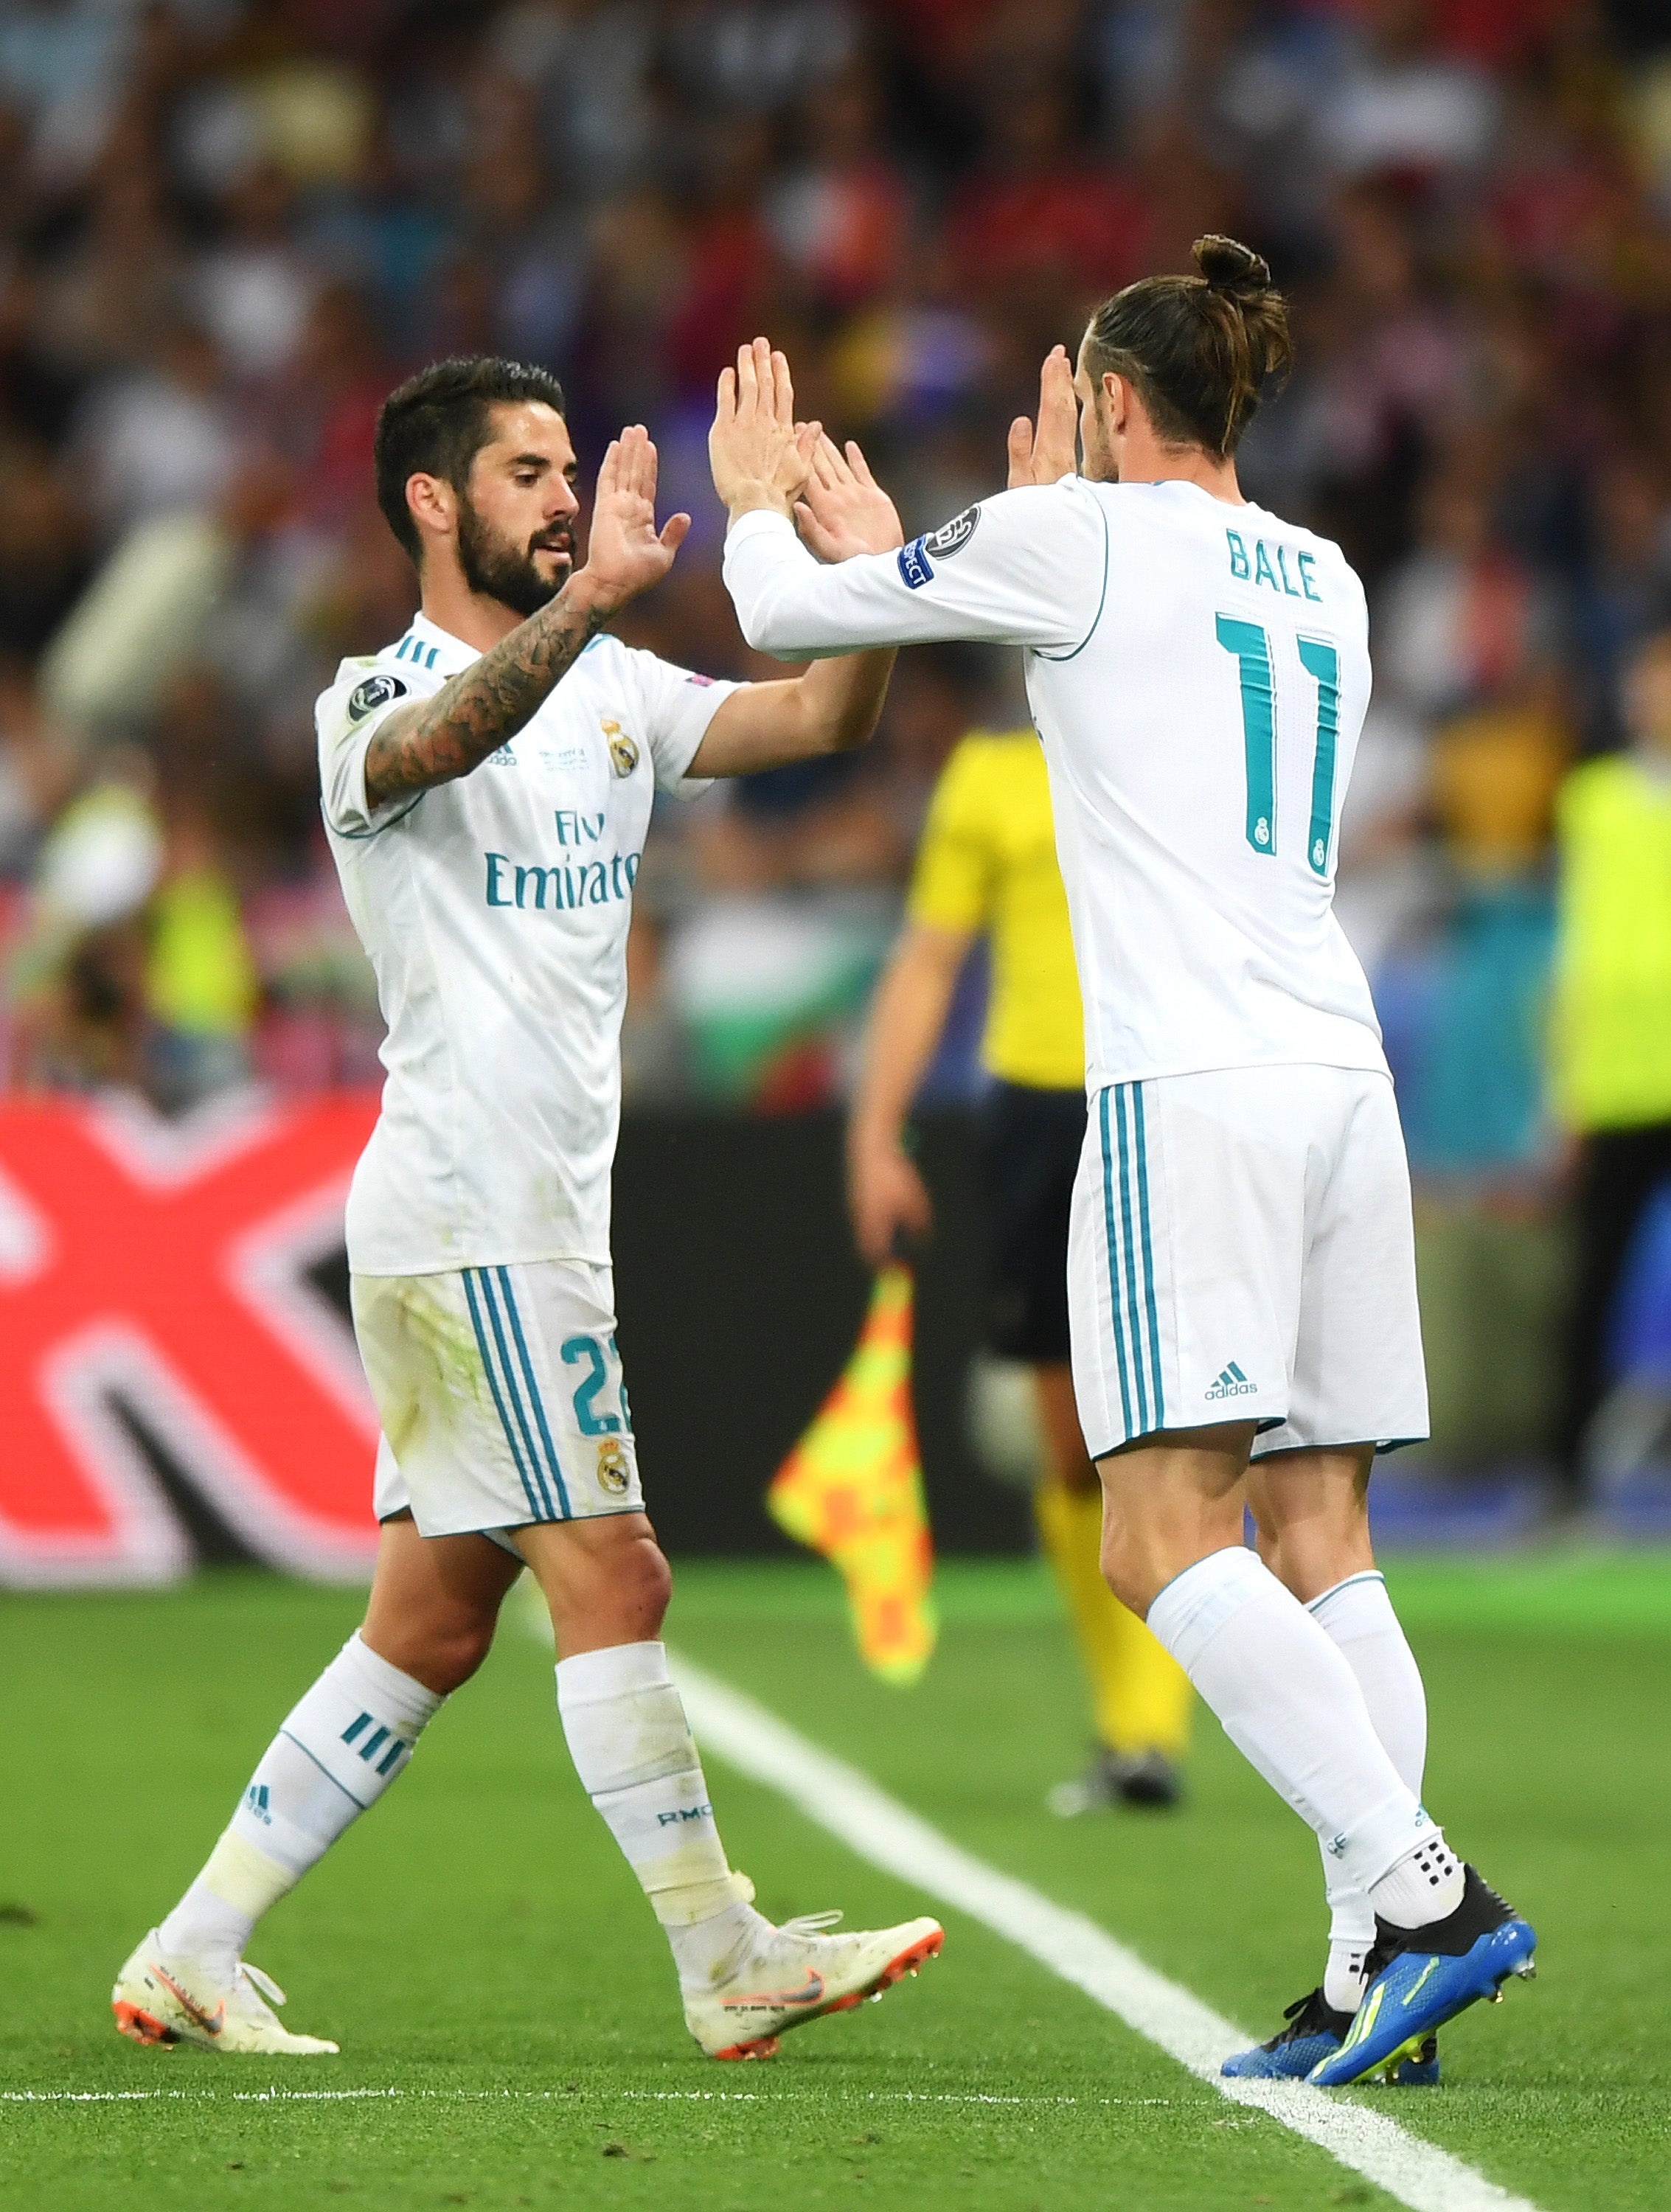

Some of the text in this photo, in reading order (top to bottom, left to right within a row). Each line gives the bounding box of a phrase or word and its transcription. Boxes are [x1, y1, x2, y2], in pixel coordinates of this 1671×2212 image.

[903, 539, 926, 585] SPECT
[1226, 527, 1324, 603] BALE
[1215, 611, 1341, 877] 11
[484, 851, 642, 910] Emirate
[560, 1335, 633, 1436] 2
[1204, 1382, 1259, 1401] adidas
